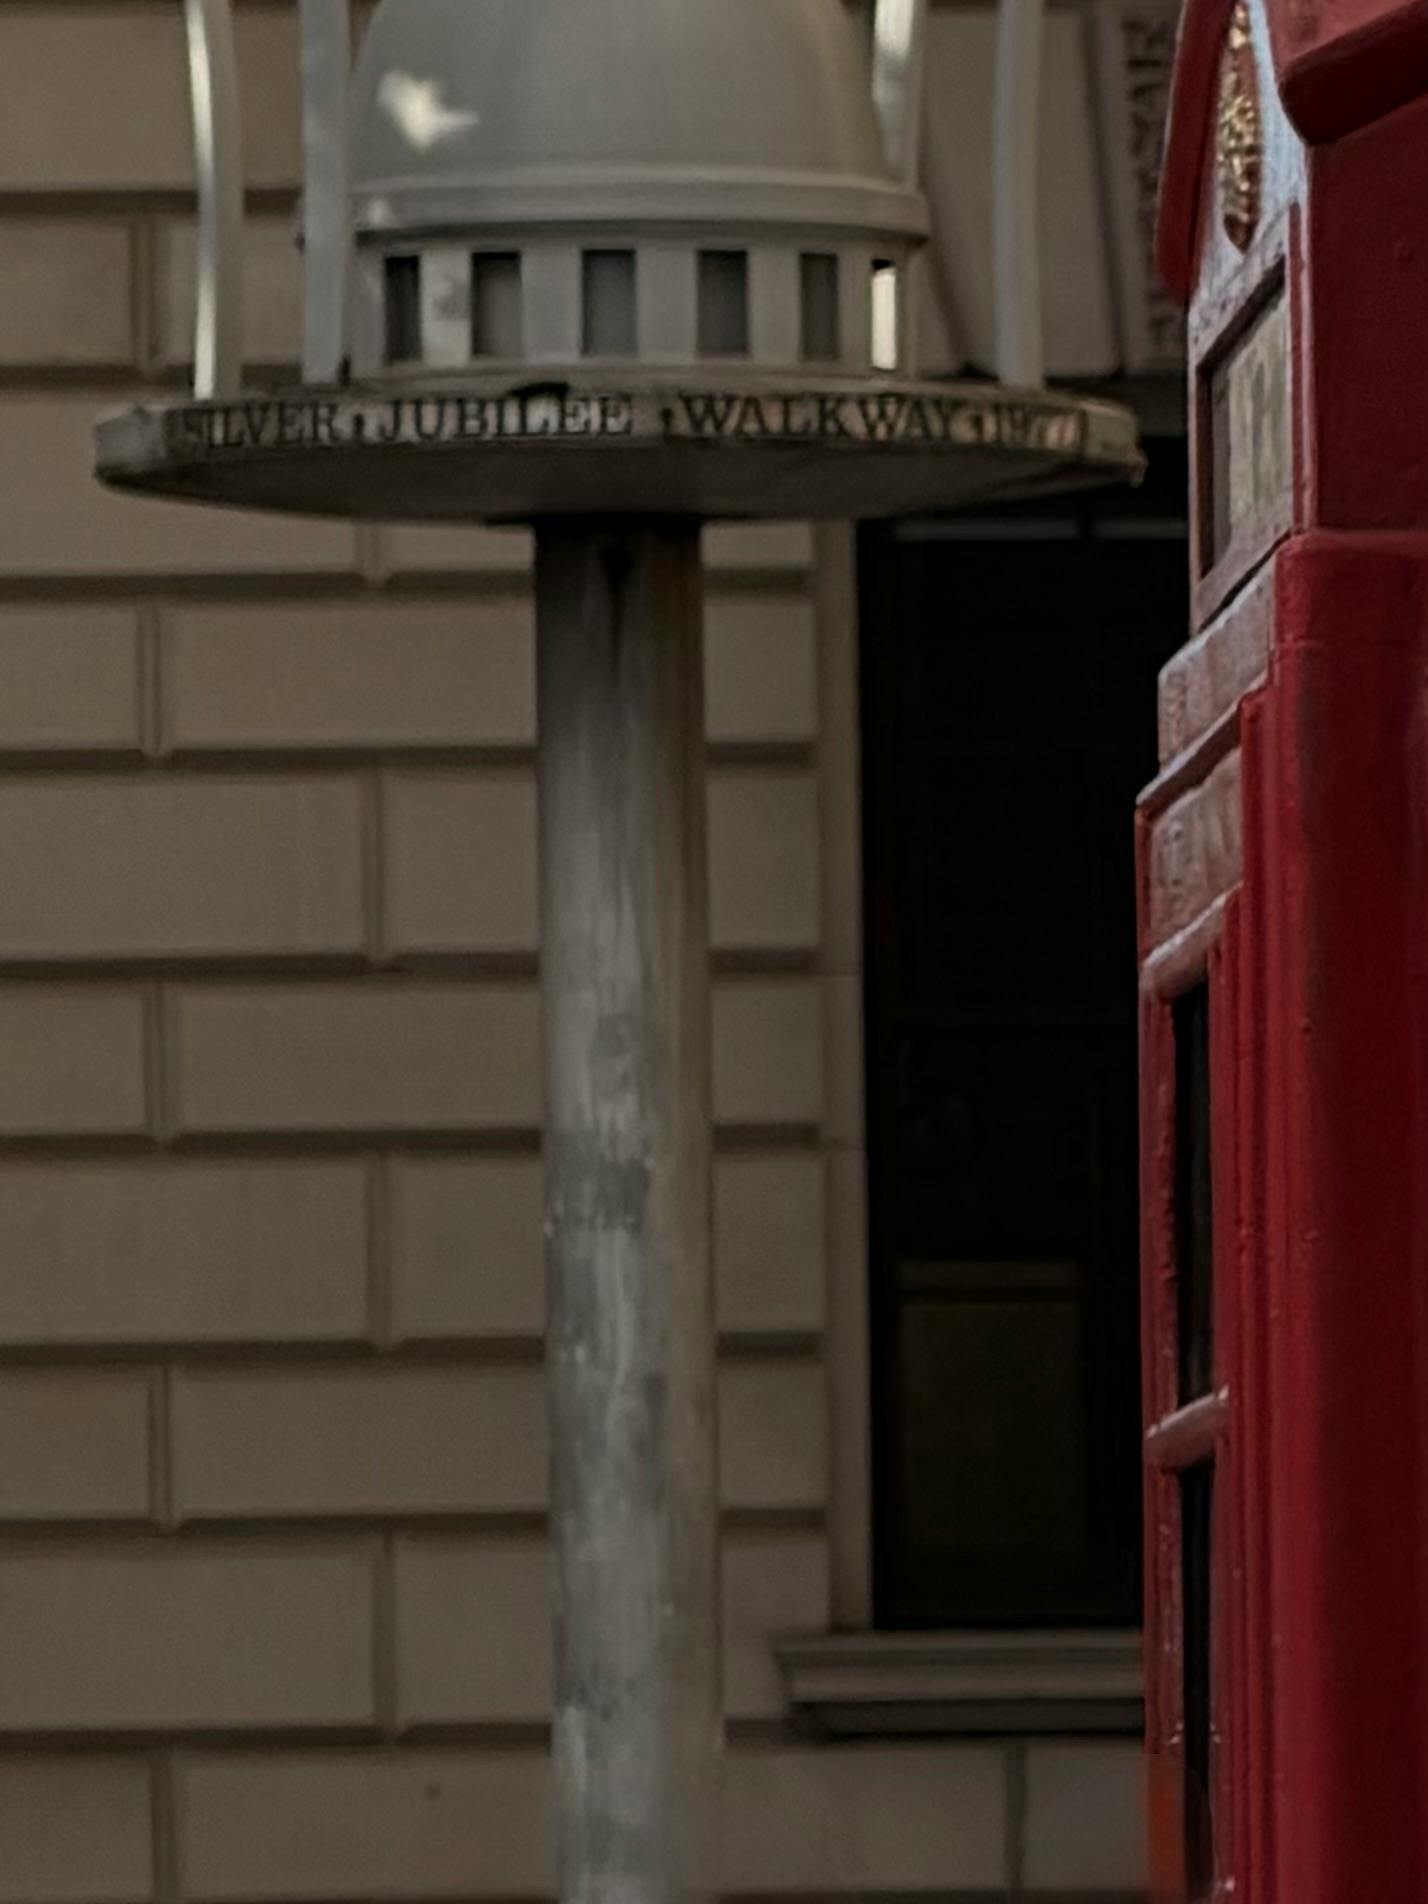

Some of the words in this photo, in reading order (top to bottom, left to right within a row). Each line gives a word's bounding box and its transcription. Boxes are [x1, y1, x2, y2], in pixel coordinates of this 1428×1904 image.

[183, 399, 344, 449] SILVER
[378, 393, 634, 443] JUBILEE
[680, 393, 958, 443] WALKWAY
